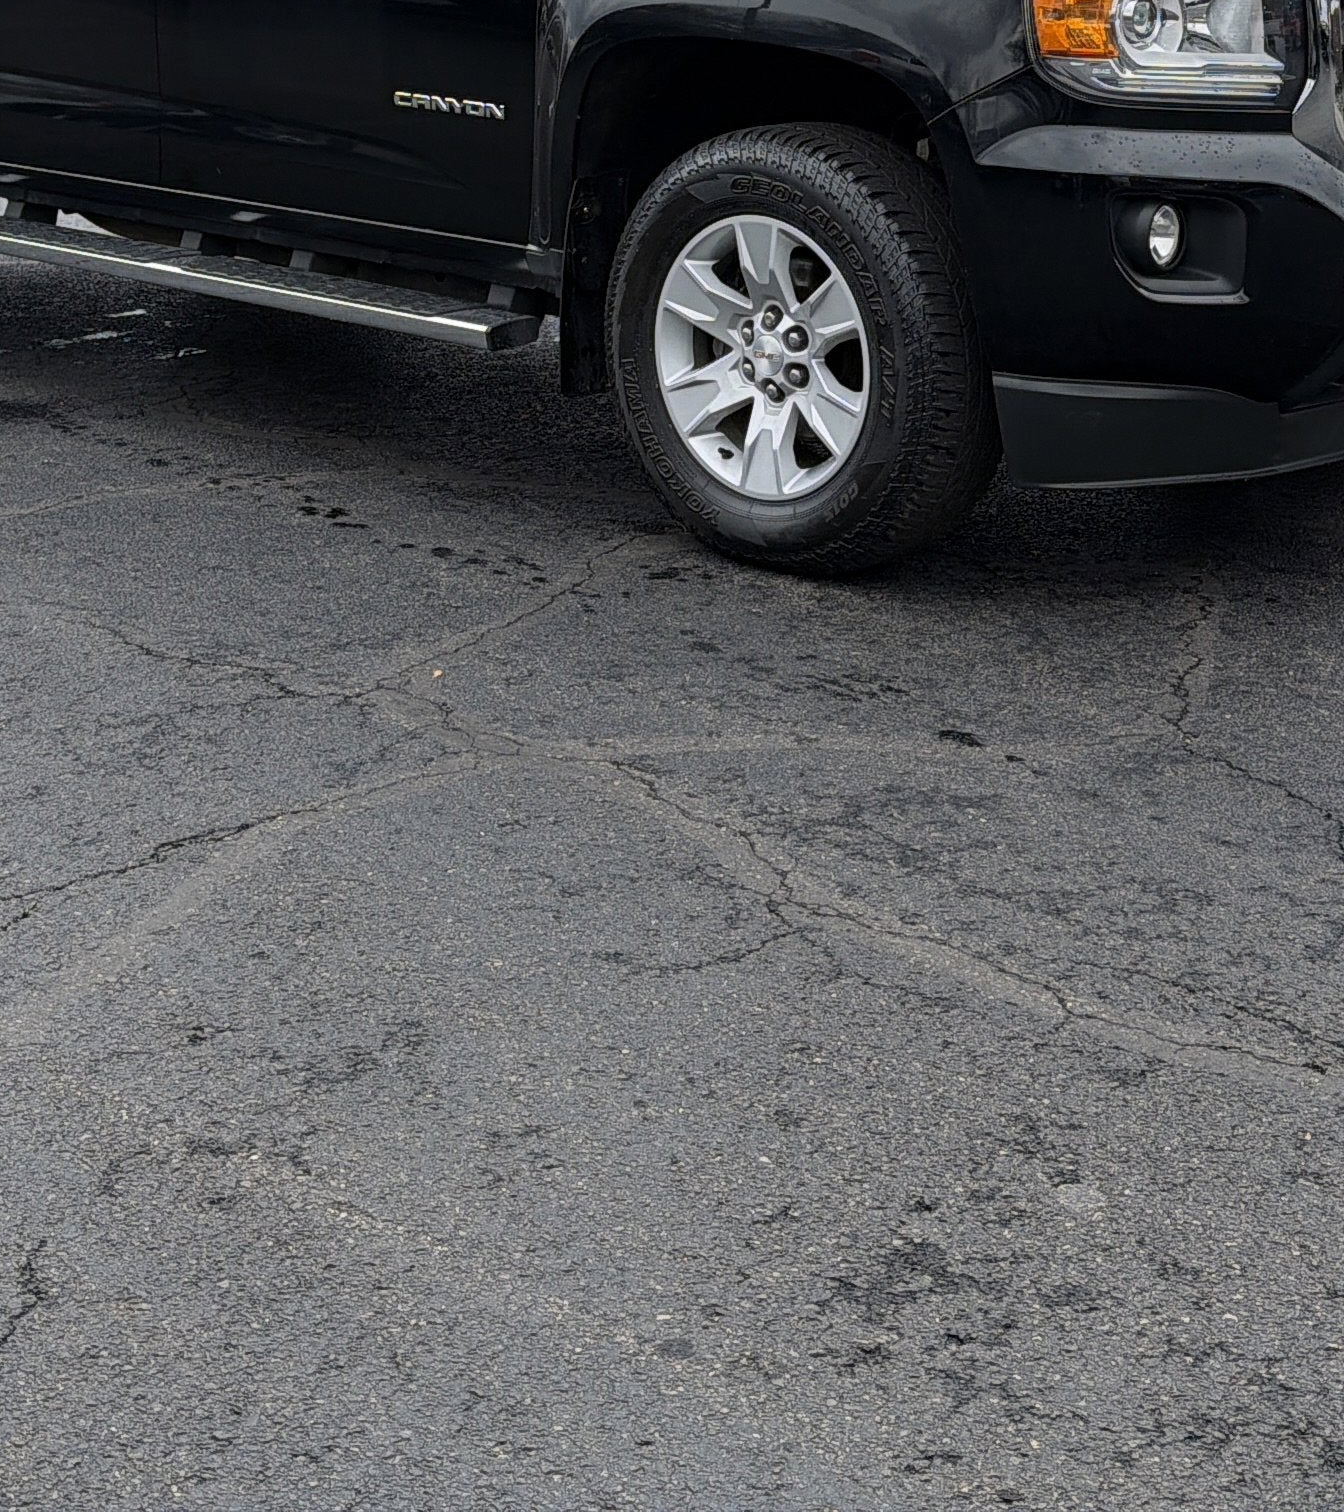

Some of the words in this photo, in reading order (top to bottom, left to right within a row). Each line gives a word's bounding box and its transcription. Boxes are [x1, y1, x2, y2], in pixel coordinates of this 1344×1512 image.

[393, 91, 505, 121] CANYON
[730, 174, 888, 327] GEOLANDAR
[621, 357, 721, 526] YOKOHAMA
